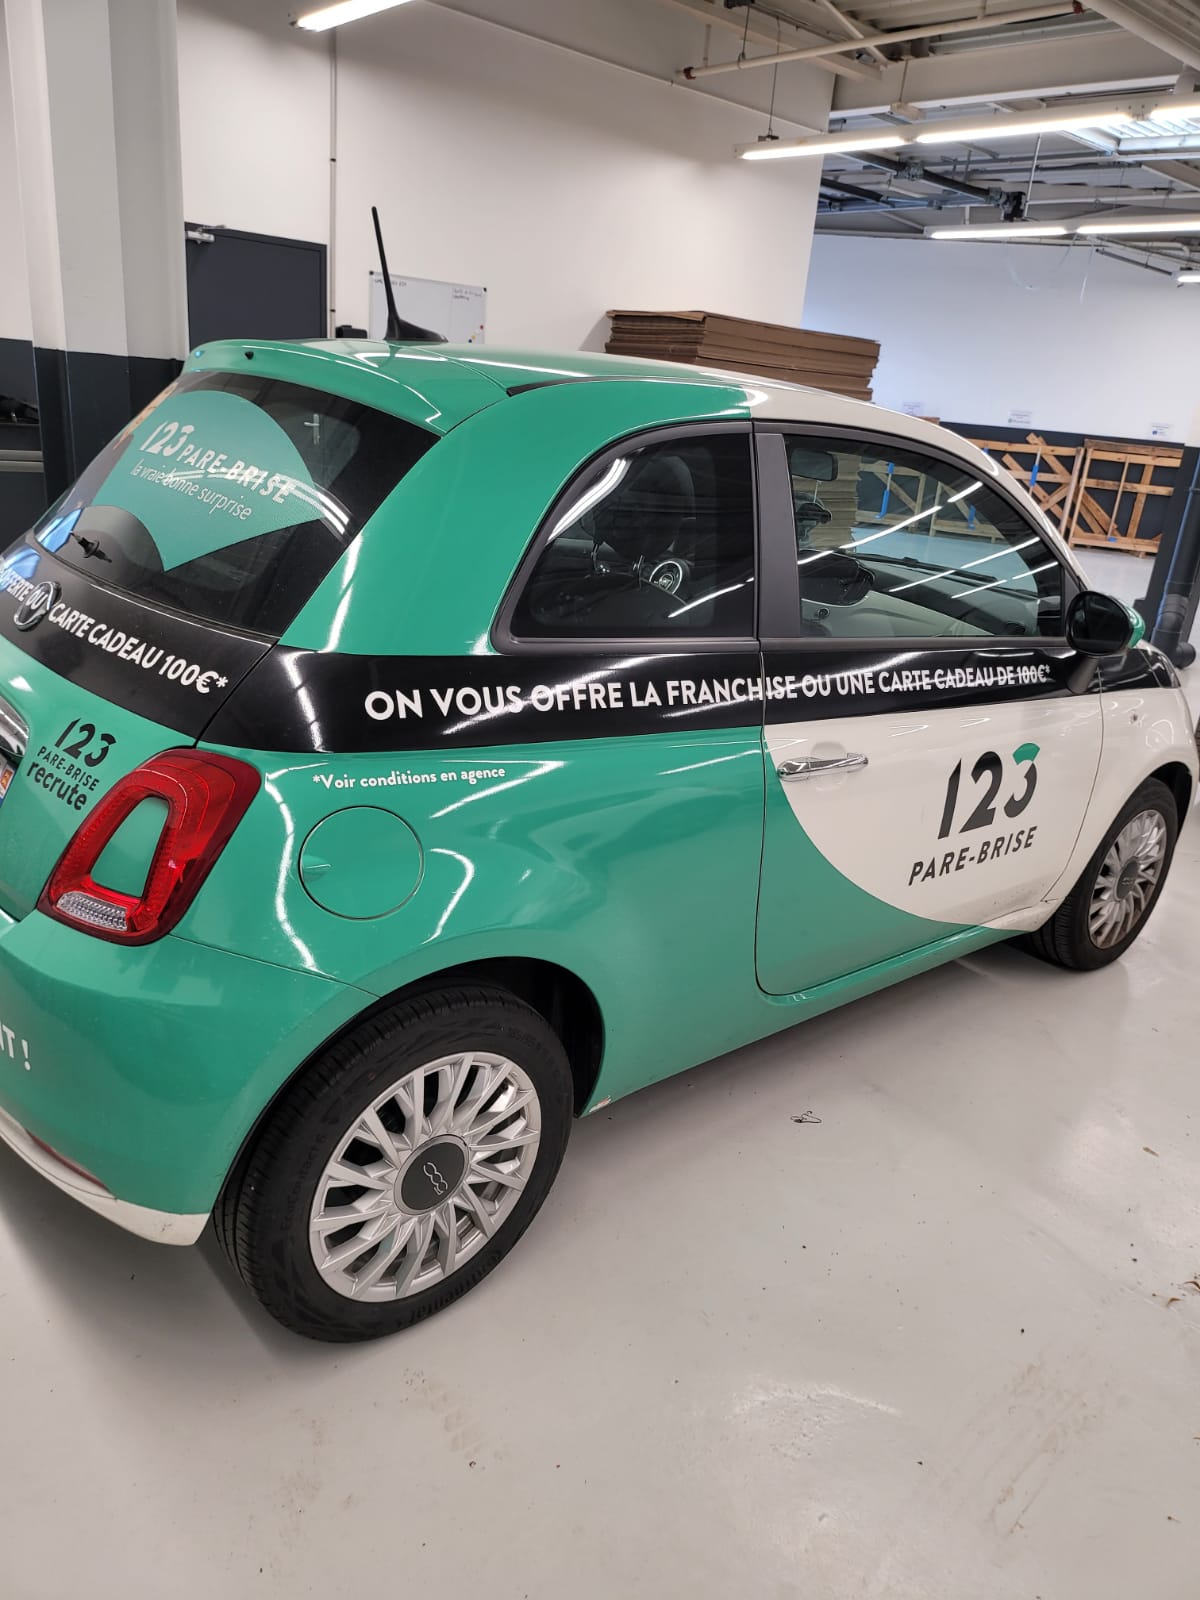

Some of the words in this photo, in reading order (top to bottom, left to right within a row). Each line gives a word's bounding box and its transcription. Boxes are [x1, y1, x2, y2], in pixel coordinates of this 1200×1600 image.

[130, 459, 144, 476] la
[140, 464, 165, 484] vraie
[197, 487, 252, 520] surprise
[139, 420, 194, 457] 123
[176, 444, 295, 504] PARE-BRISE
[48, 603, 96, 638] CARTE
[87, 623, 164, 669] CADEAU
[364, 689, 423, 720] ON
[429, 685, 522, 717] VOUS
[531, 681, 624, 712] OFFRE
[629, 680, 662, 707] LA
[666, 675, 797, 706] FRANCHISE
[801, 674, 831, 698] OU
[834, 671, 875, 696] UNE
[878, 669, 932, 692] CARTE
[934, 666, 993, 690] CADEAU
[997, 665, 1015, 686] DE
[37, 746, 100, 791] PARE-BRISE
[54, 717, 117, 767] 123
[26, 761, 87, 810] recrute
[360, 770, 437, 788] conditions
[440, 770, 457, 782] en
[460, 768, 506, 785] agence
[937, 742, 1041, 840] 123
[908, 826, 1037, 886] PARE-BRISE
